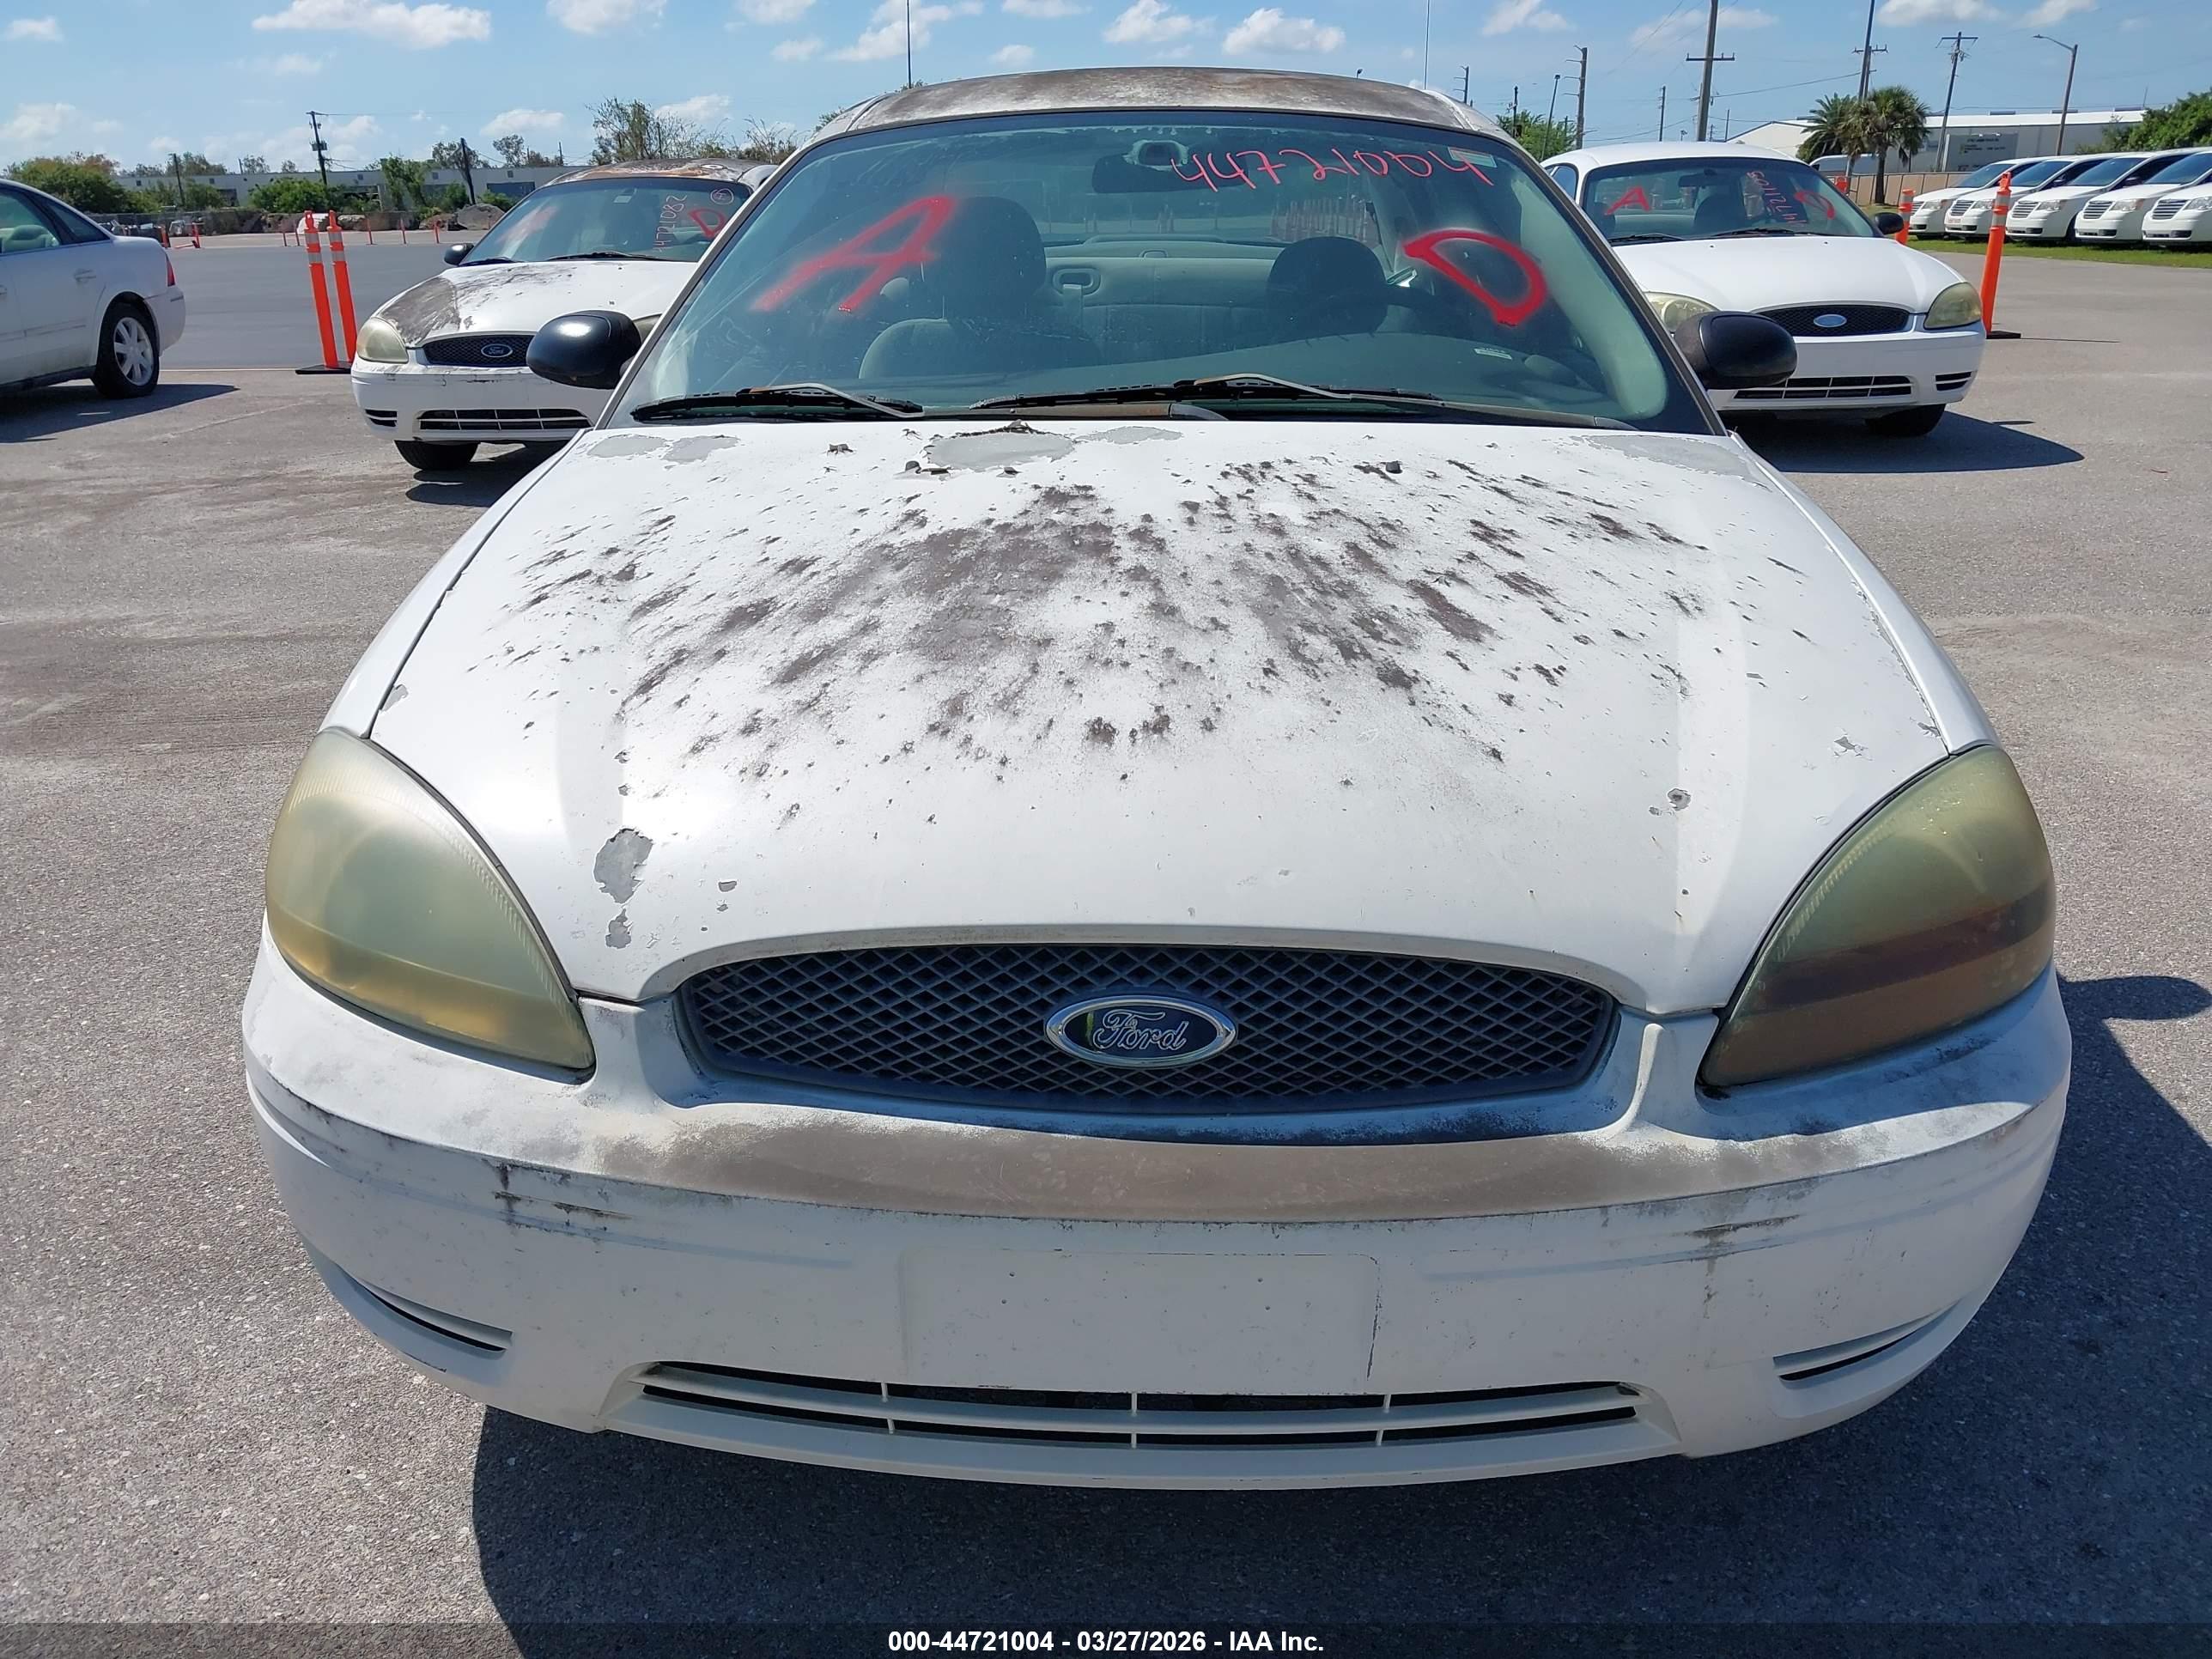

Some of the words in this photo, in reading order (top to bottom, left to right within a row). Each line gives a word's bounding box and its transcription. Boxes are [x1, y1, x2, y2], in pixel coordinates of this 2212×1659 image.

[1170, 147, 1494, 192] 44721004
[1604, 185, 1650, 216] A
[688, 208, 727, 240] D
[752, 194, 957, 313] A
[1402, 228, 1547, 327] D
[1093, 1009, 1188, 1051] Ford
